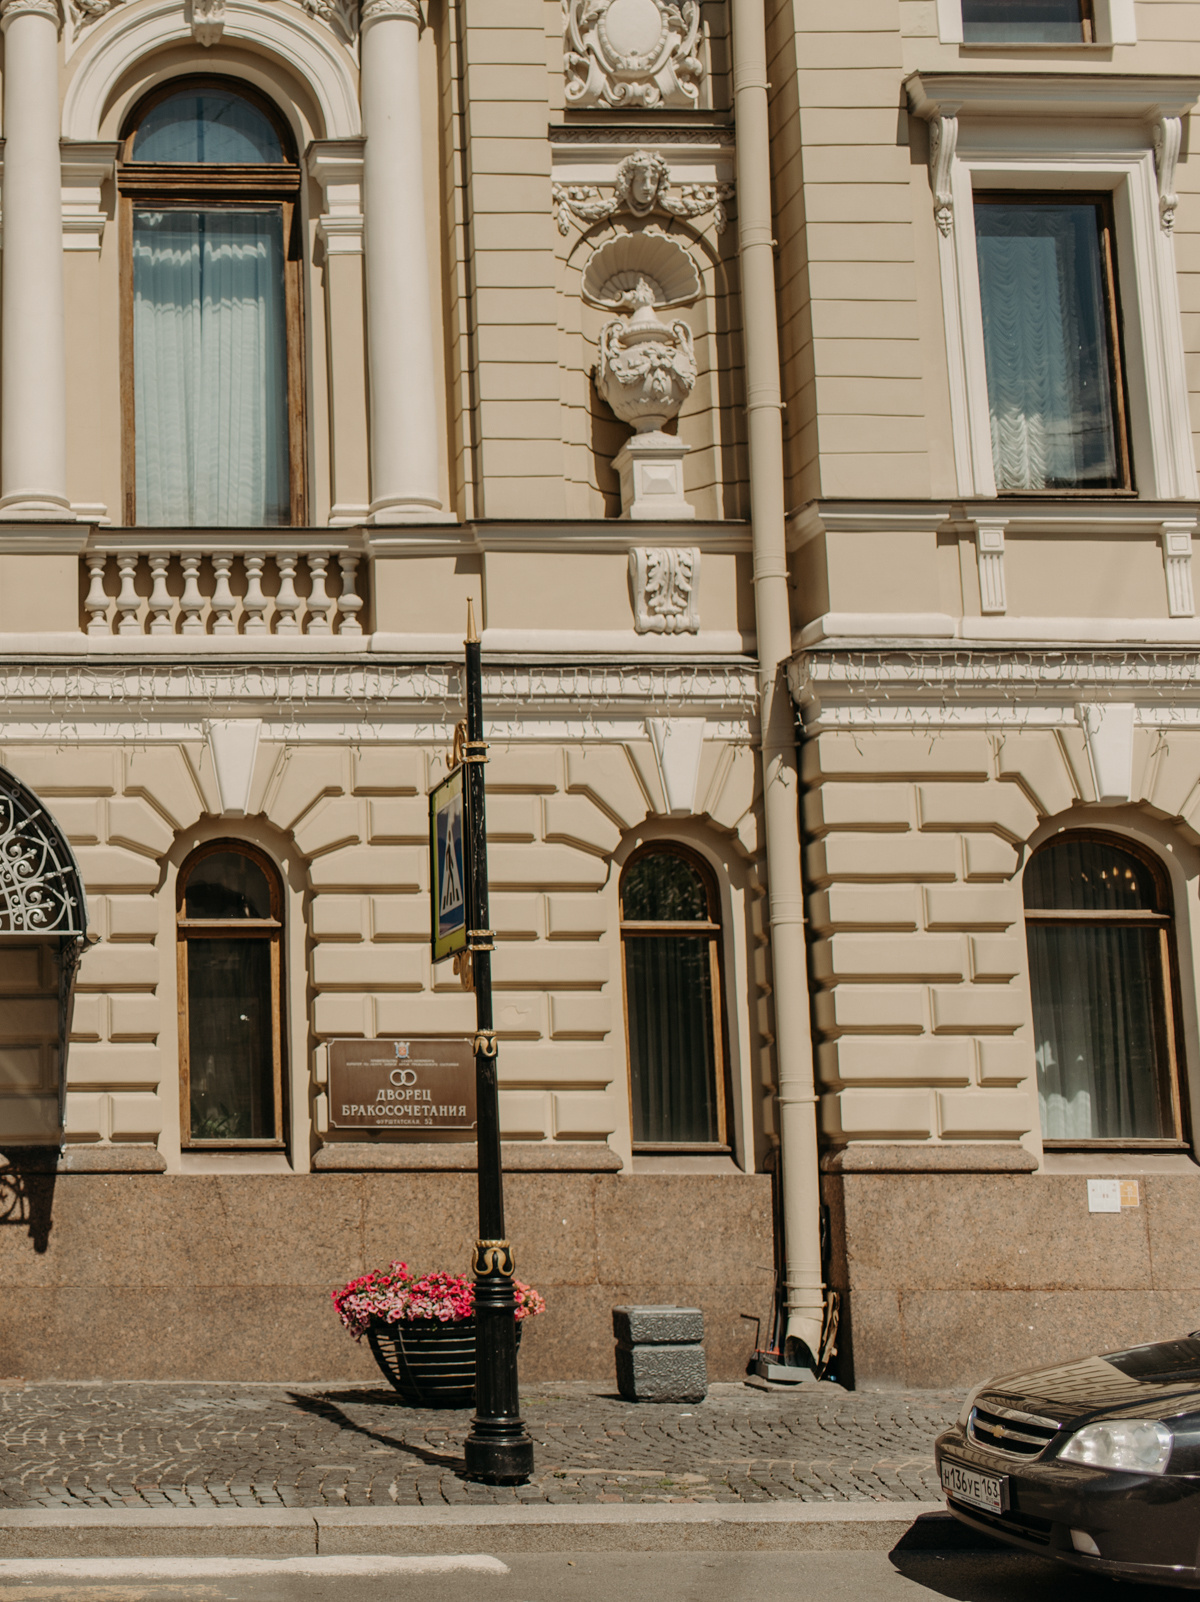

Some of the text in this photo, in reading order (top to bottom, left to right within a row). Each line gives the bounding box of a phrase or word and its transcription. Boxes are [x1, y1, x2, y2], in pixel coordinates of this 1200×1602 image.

[376, 1089, 432, 1102] ДВОРЕЦ
[342, 1104, 467, 1116] БРАКОСОЧЕТАНИЯ
[982, 1478, 998, 1498] 163
